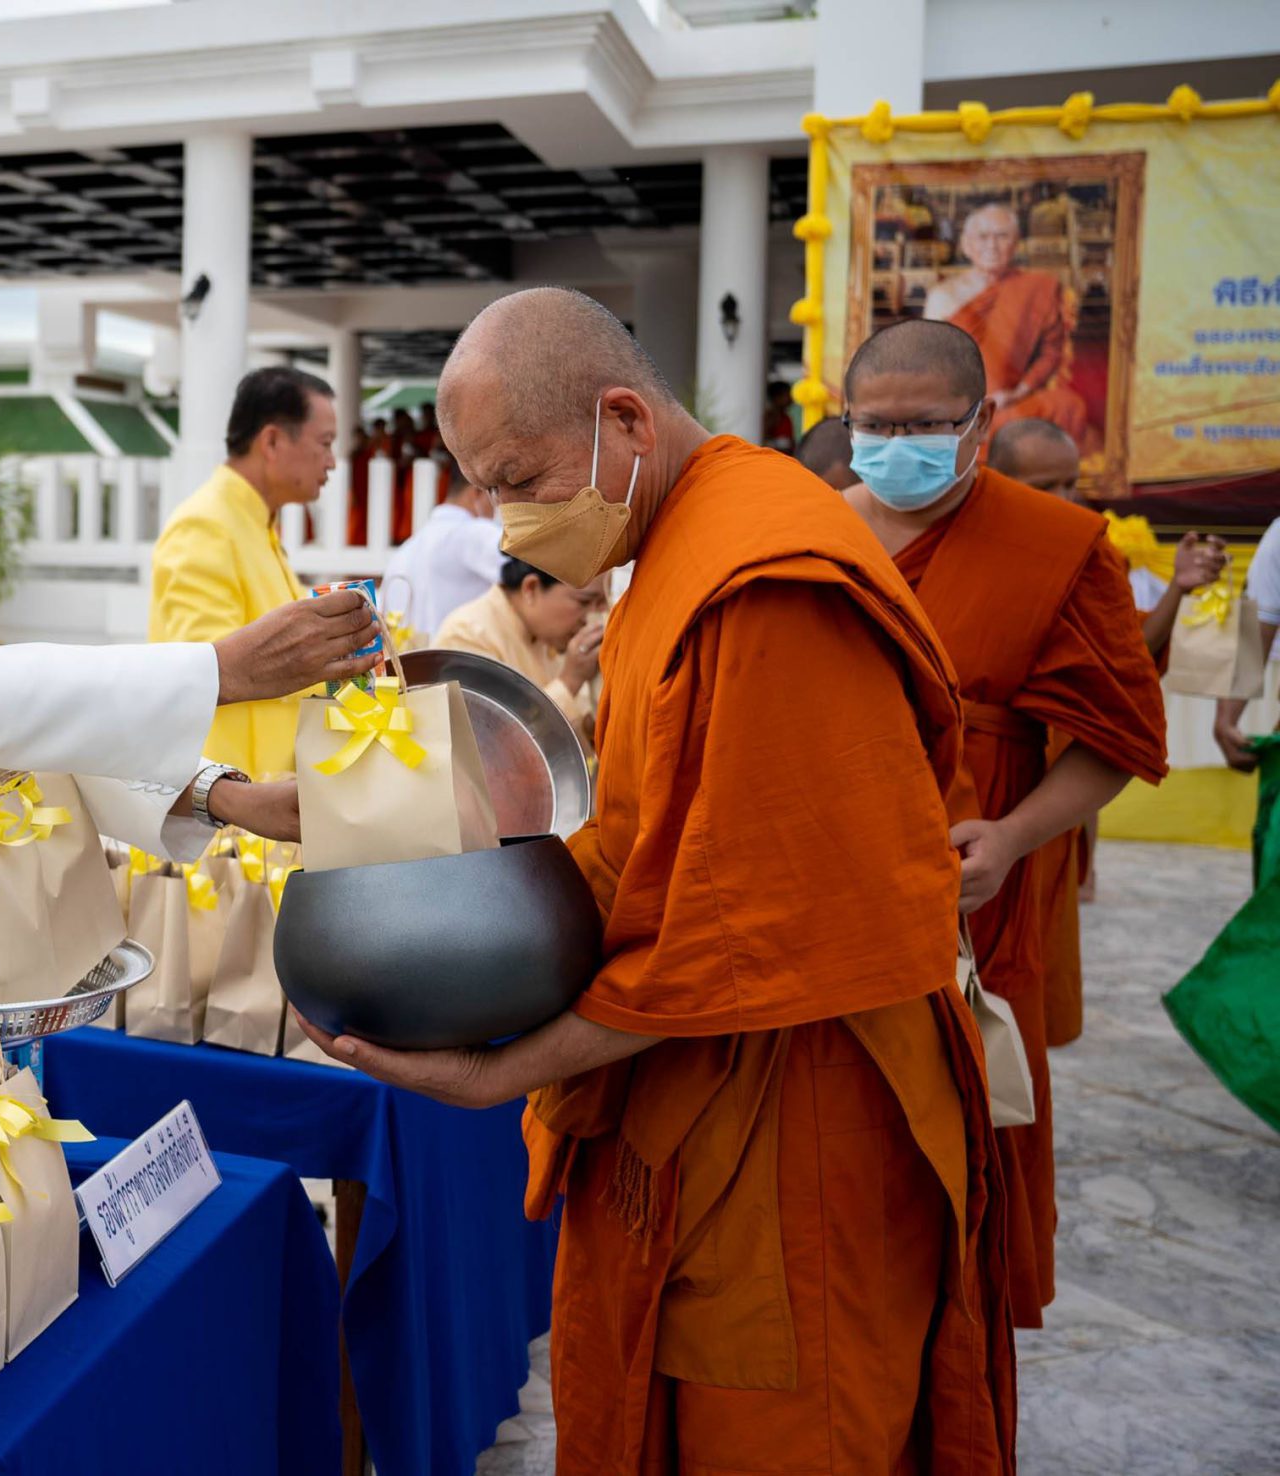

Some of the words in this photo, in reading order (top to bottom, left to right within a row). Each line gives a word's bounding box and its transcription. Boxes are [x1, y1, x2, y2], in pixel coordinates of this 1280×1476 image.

[96, 1111, 207, 1245] รองผู้ว่าราชการจังหวัดสิงห์บุรี
